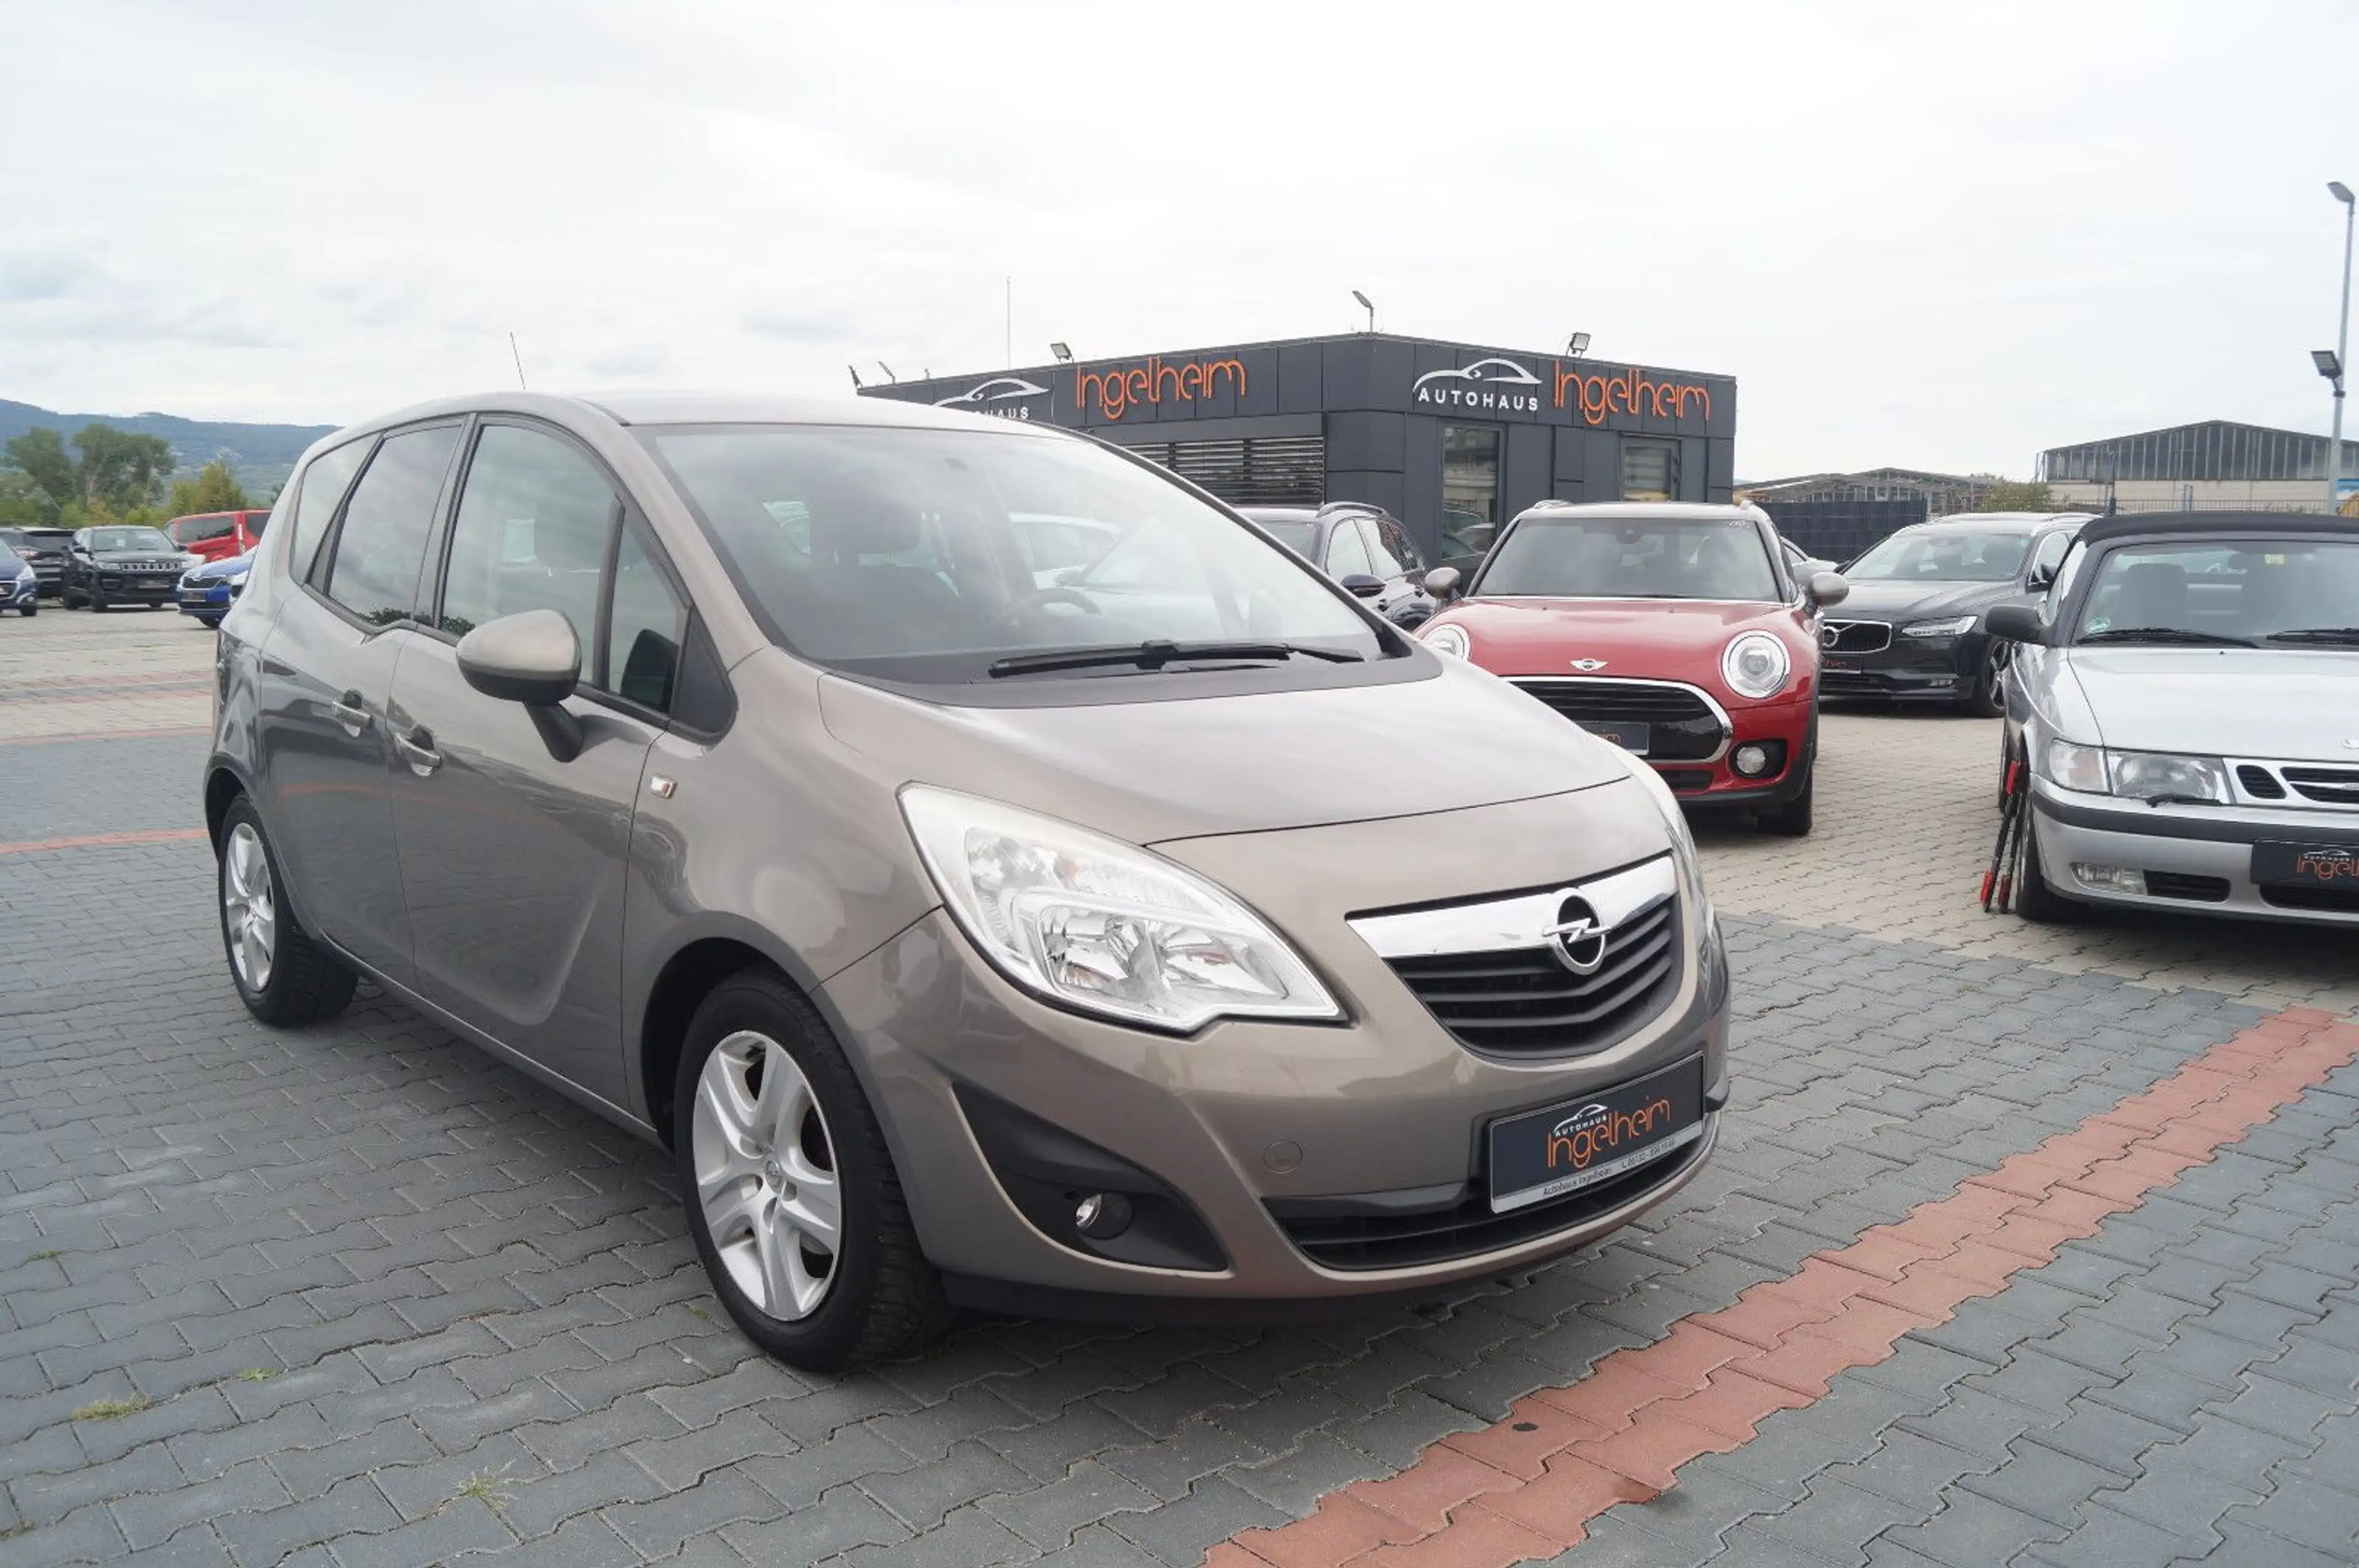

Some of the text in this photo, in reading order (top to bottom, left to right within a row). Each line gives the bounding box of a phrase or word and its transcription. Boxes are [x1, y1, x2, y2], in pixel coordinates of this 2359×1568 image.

[1077, 356, 1246, 420] Ingelheim
[1418, 387, 1538, 411] AUTOHAUS
[1554, 359, 1710, 424] Ingelheim
[1547, 1099, 1671, 1169] Ingelheim
[1555, 1114, 1608, 1137] AUTOHAUS
